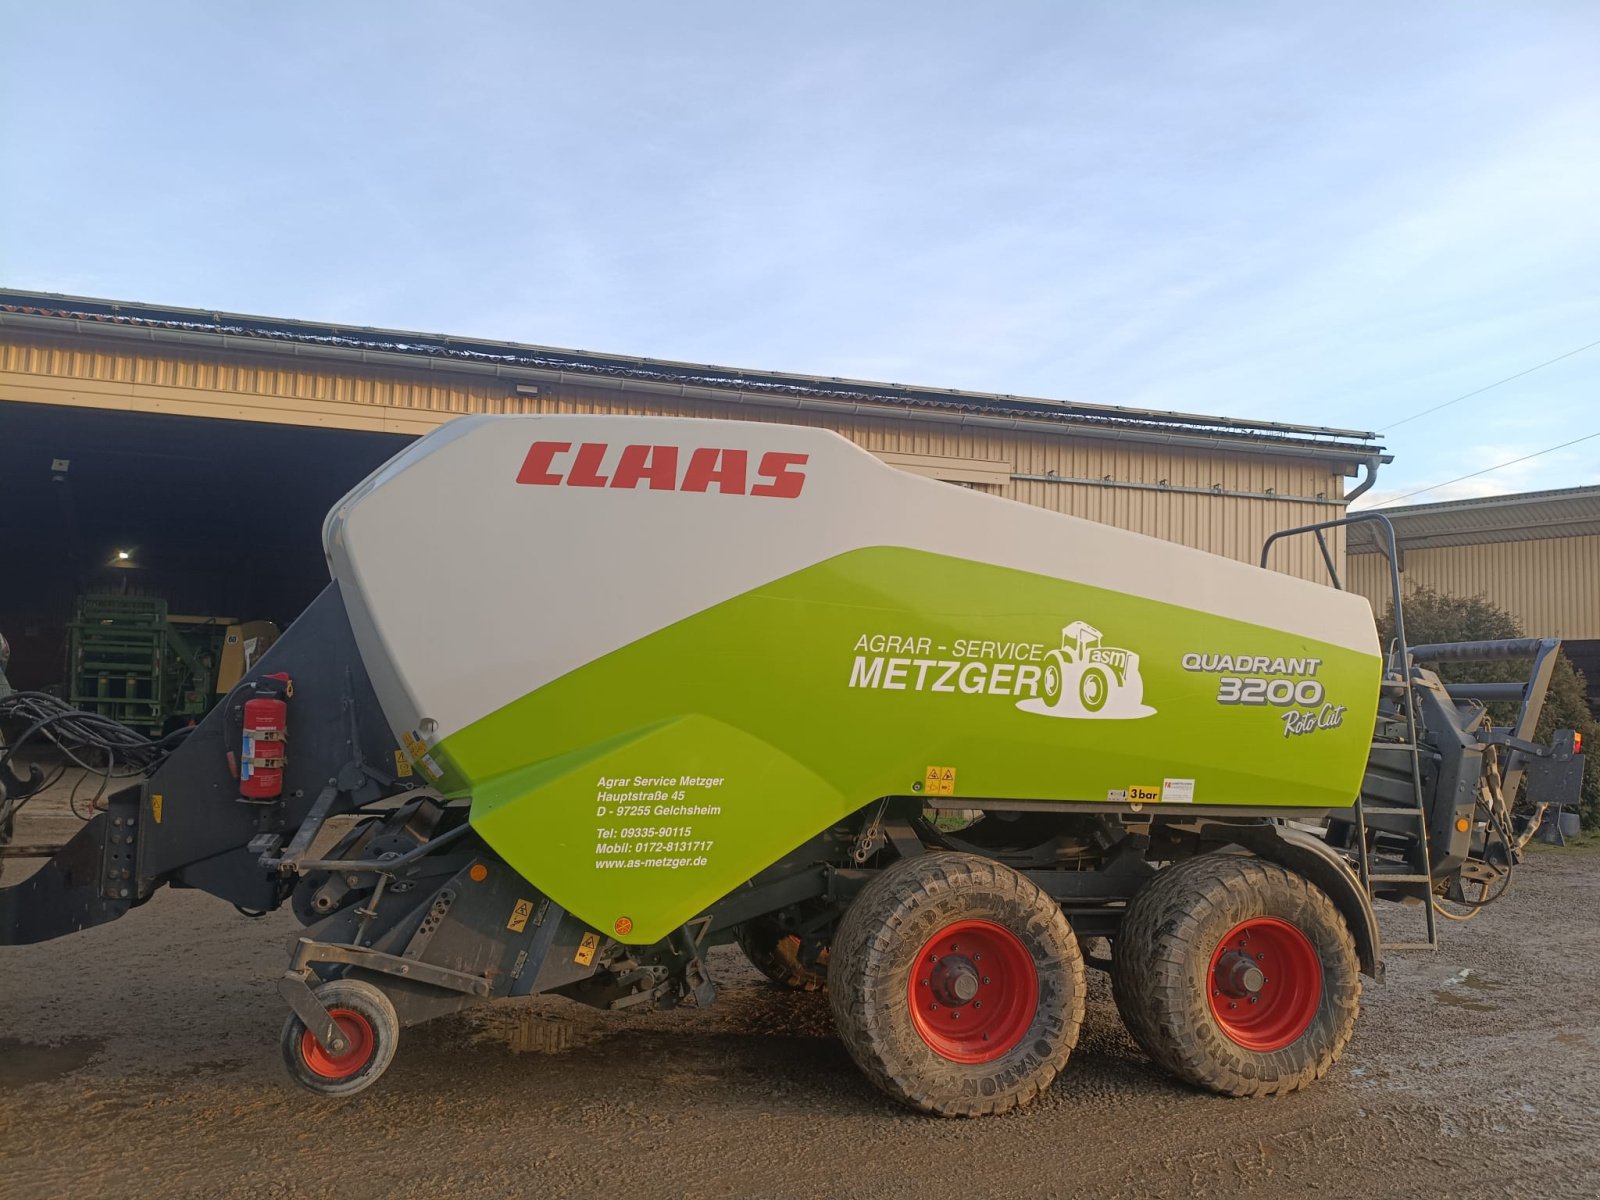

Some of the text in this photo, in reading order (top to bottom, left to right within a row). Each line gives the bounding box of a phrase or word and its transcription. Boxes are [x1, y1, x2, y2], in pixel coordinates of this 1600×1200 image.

[516, 441, 809, 498] CLAAS
[854, 634, 932, 655] AGRAR
[952, 639, 1043, 661] SERVICE
[1091, 649, 1125, 667] asm
[1181, 652, 1322, 676] QUADRANT
[849, 656, 1041, 696] METZGER
[1216, 677, 1325, 707] 3200
[1281, 702, 1347, 738] Roto Cut
[597, 775, 724, 789] Agrar Service Metzger
[597, 790, 685, 803] Hauptstraße 45
[1130, 788, 1137, 799] 3
[1138, 789, 1158, 800] bar
[597, 806, 606, 817] D
[616, 806, 650, 816] 97255
[653, 804, 721, 816] Gelchsheim
[597, 827, 691, 839] Tel: 09335-90115
[595, 841, 713, 854] Mobil: 0172-8131717
[595, 856, 707, 869] www.as-metzger.de
